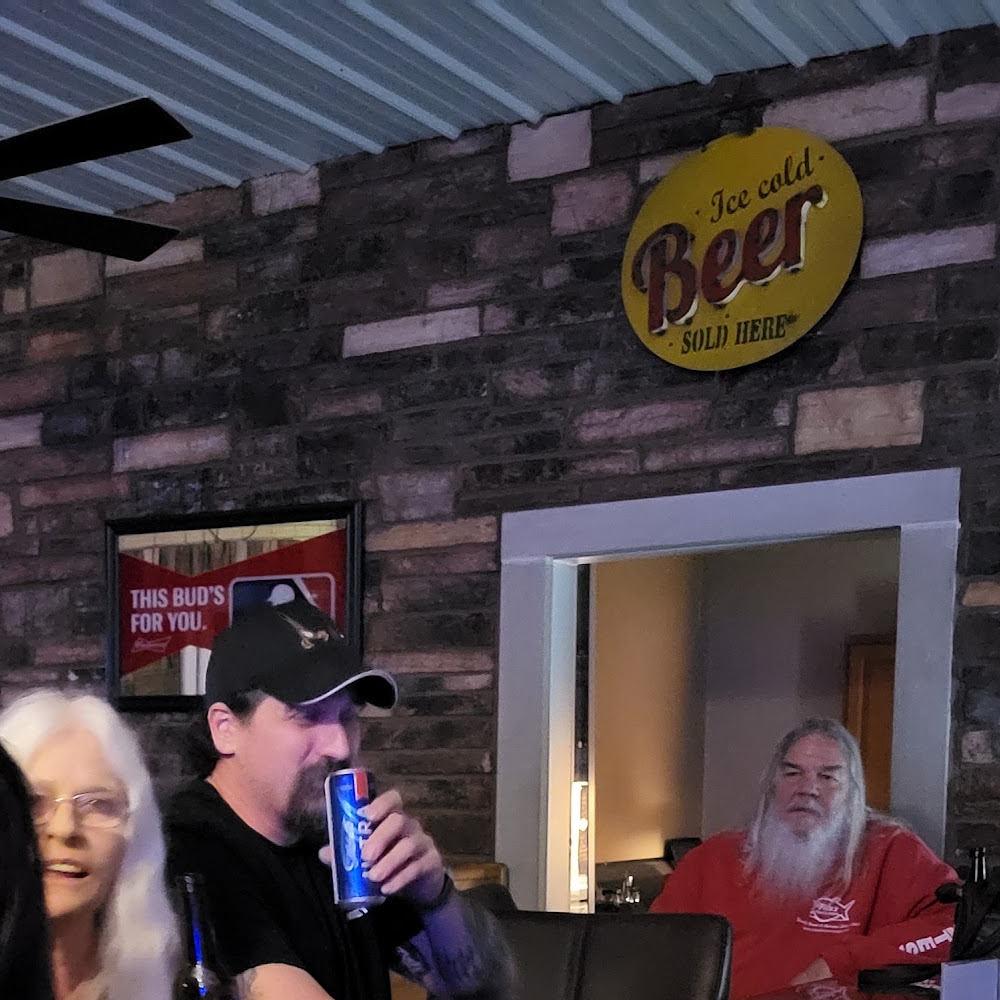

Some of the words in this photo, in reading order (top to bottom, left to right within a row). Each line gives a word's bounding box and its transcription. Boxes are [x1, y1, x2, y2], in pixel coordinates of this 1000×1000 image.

[710, 189, 751, 223] Ice
[758, 147, 813, 199] cold
[632, 184, 828, 335] Beer
[681, 324, 728, 355] SOLD
[735, 314, 788, 345] HERE
[130, 588, 169, 609] THIS
[172, 585, 225, 608] BUD'S
[130, 613, 163, 634] FOR
[168, 611, 208, 632] YOU.
